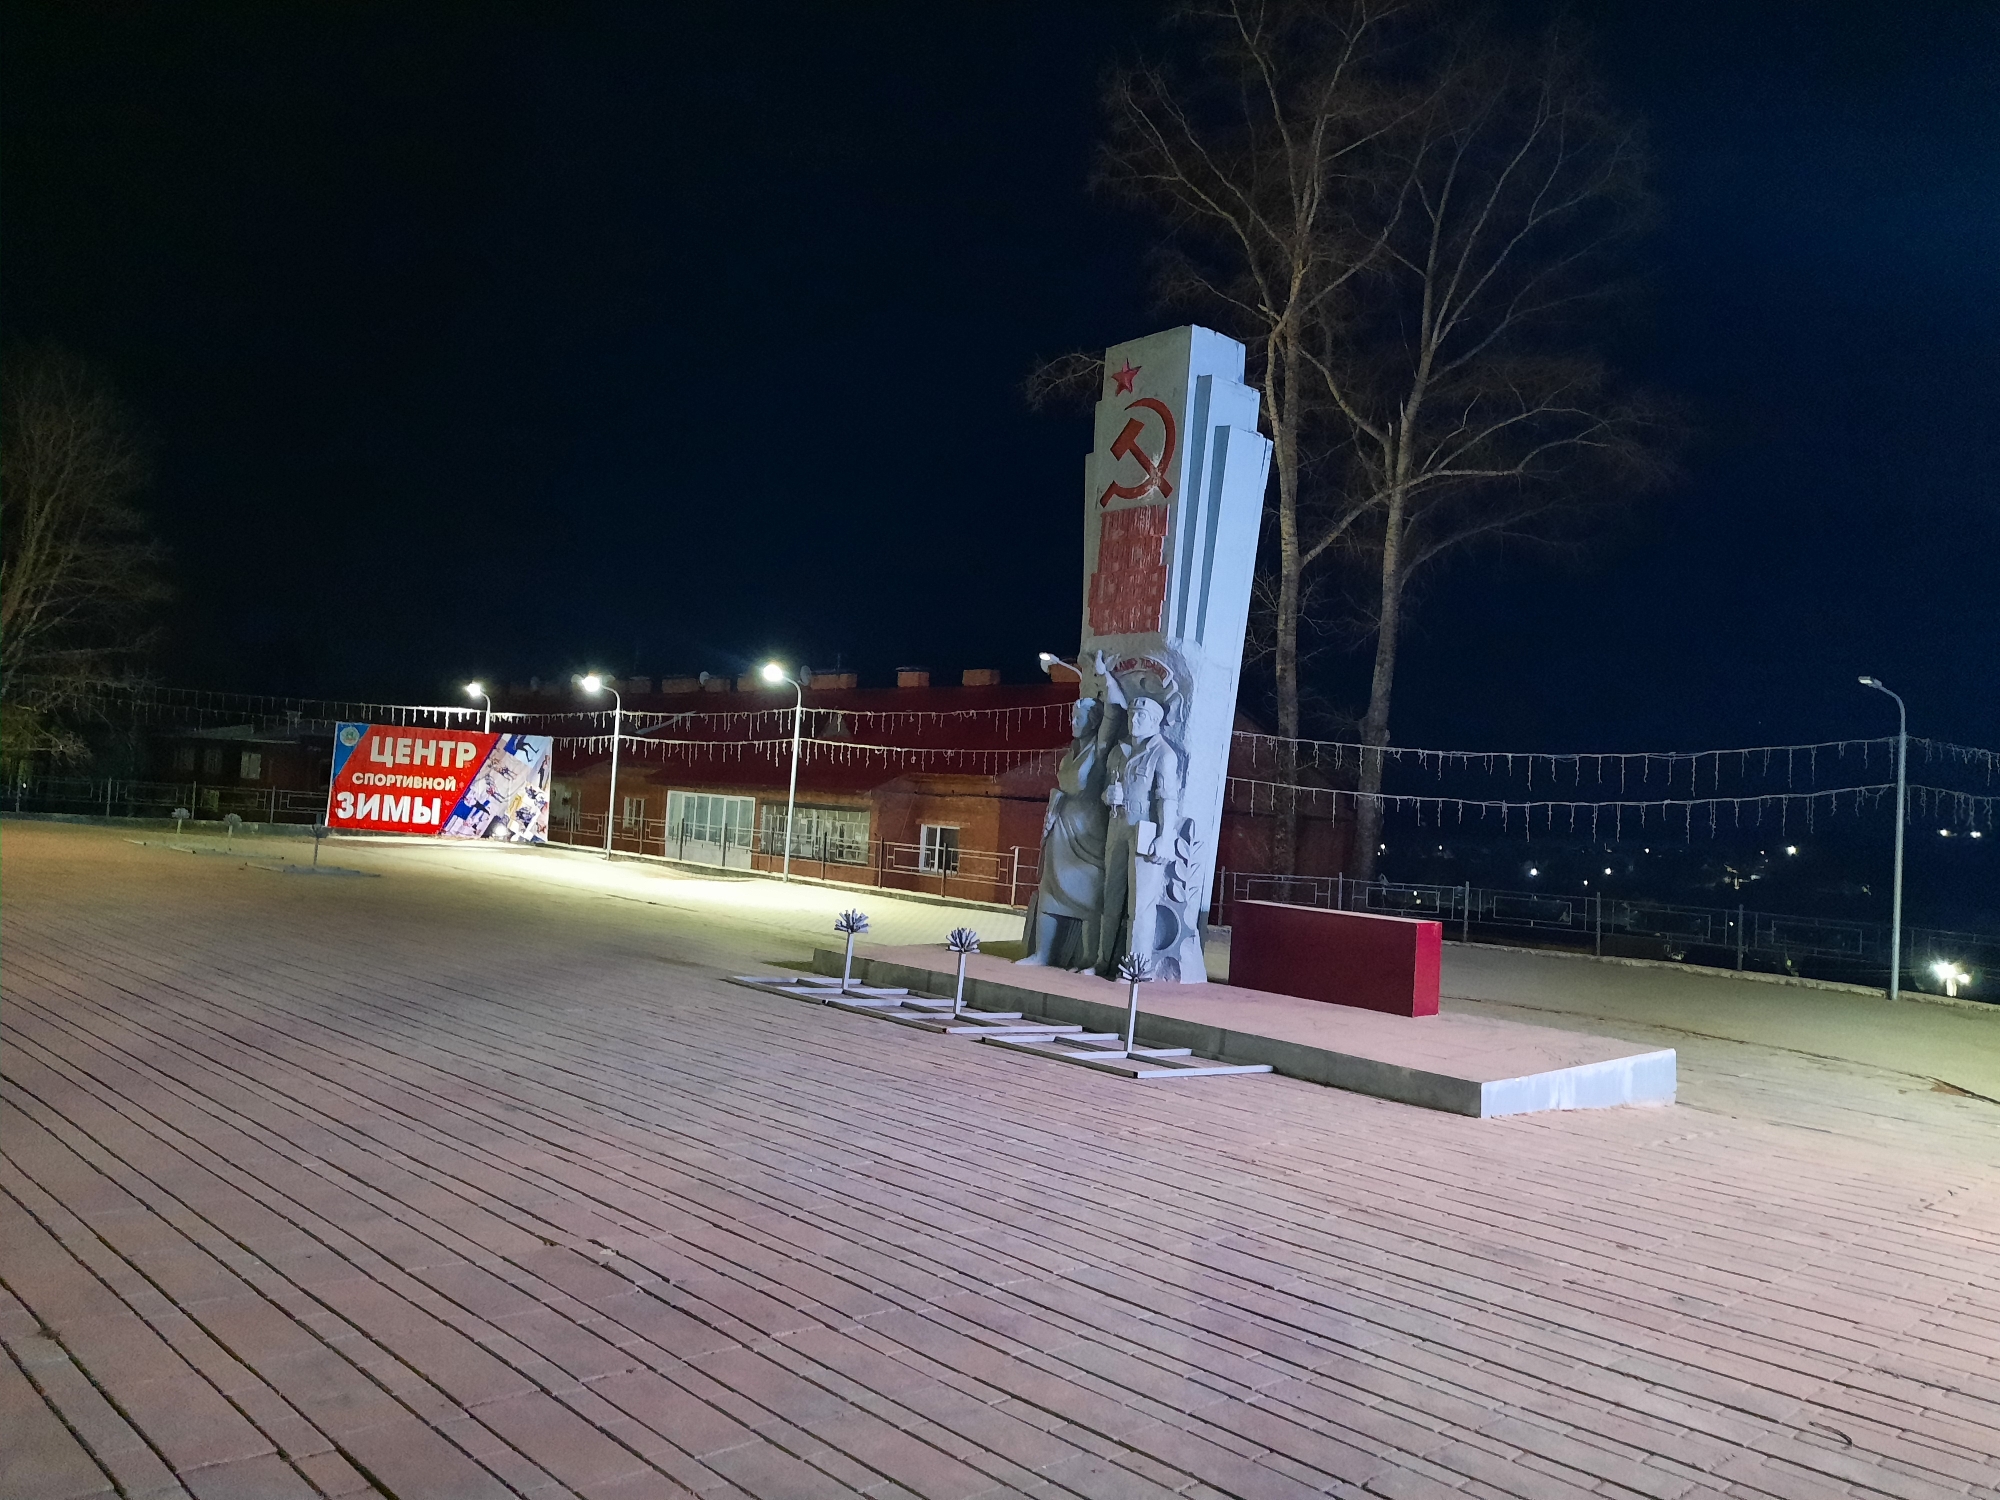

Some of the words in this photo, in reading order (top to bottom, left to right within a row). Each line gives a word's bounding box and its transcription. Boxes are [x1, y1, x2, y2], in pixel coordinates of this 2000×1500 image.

[370, 736, 477, 768] ЦЕНТР
[352, 773, 457, 791] СПОРТИВНОЙ
[336, 792, 441, 825] ЗИМЫ
